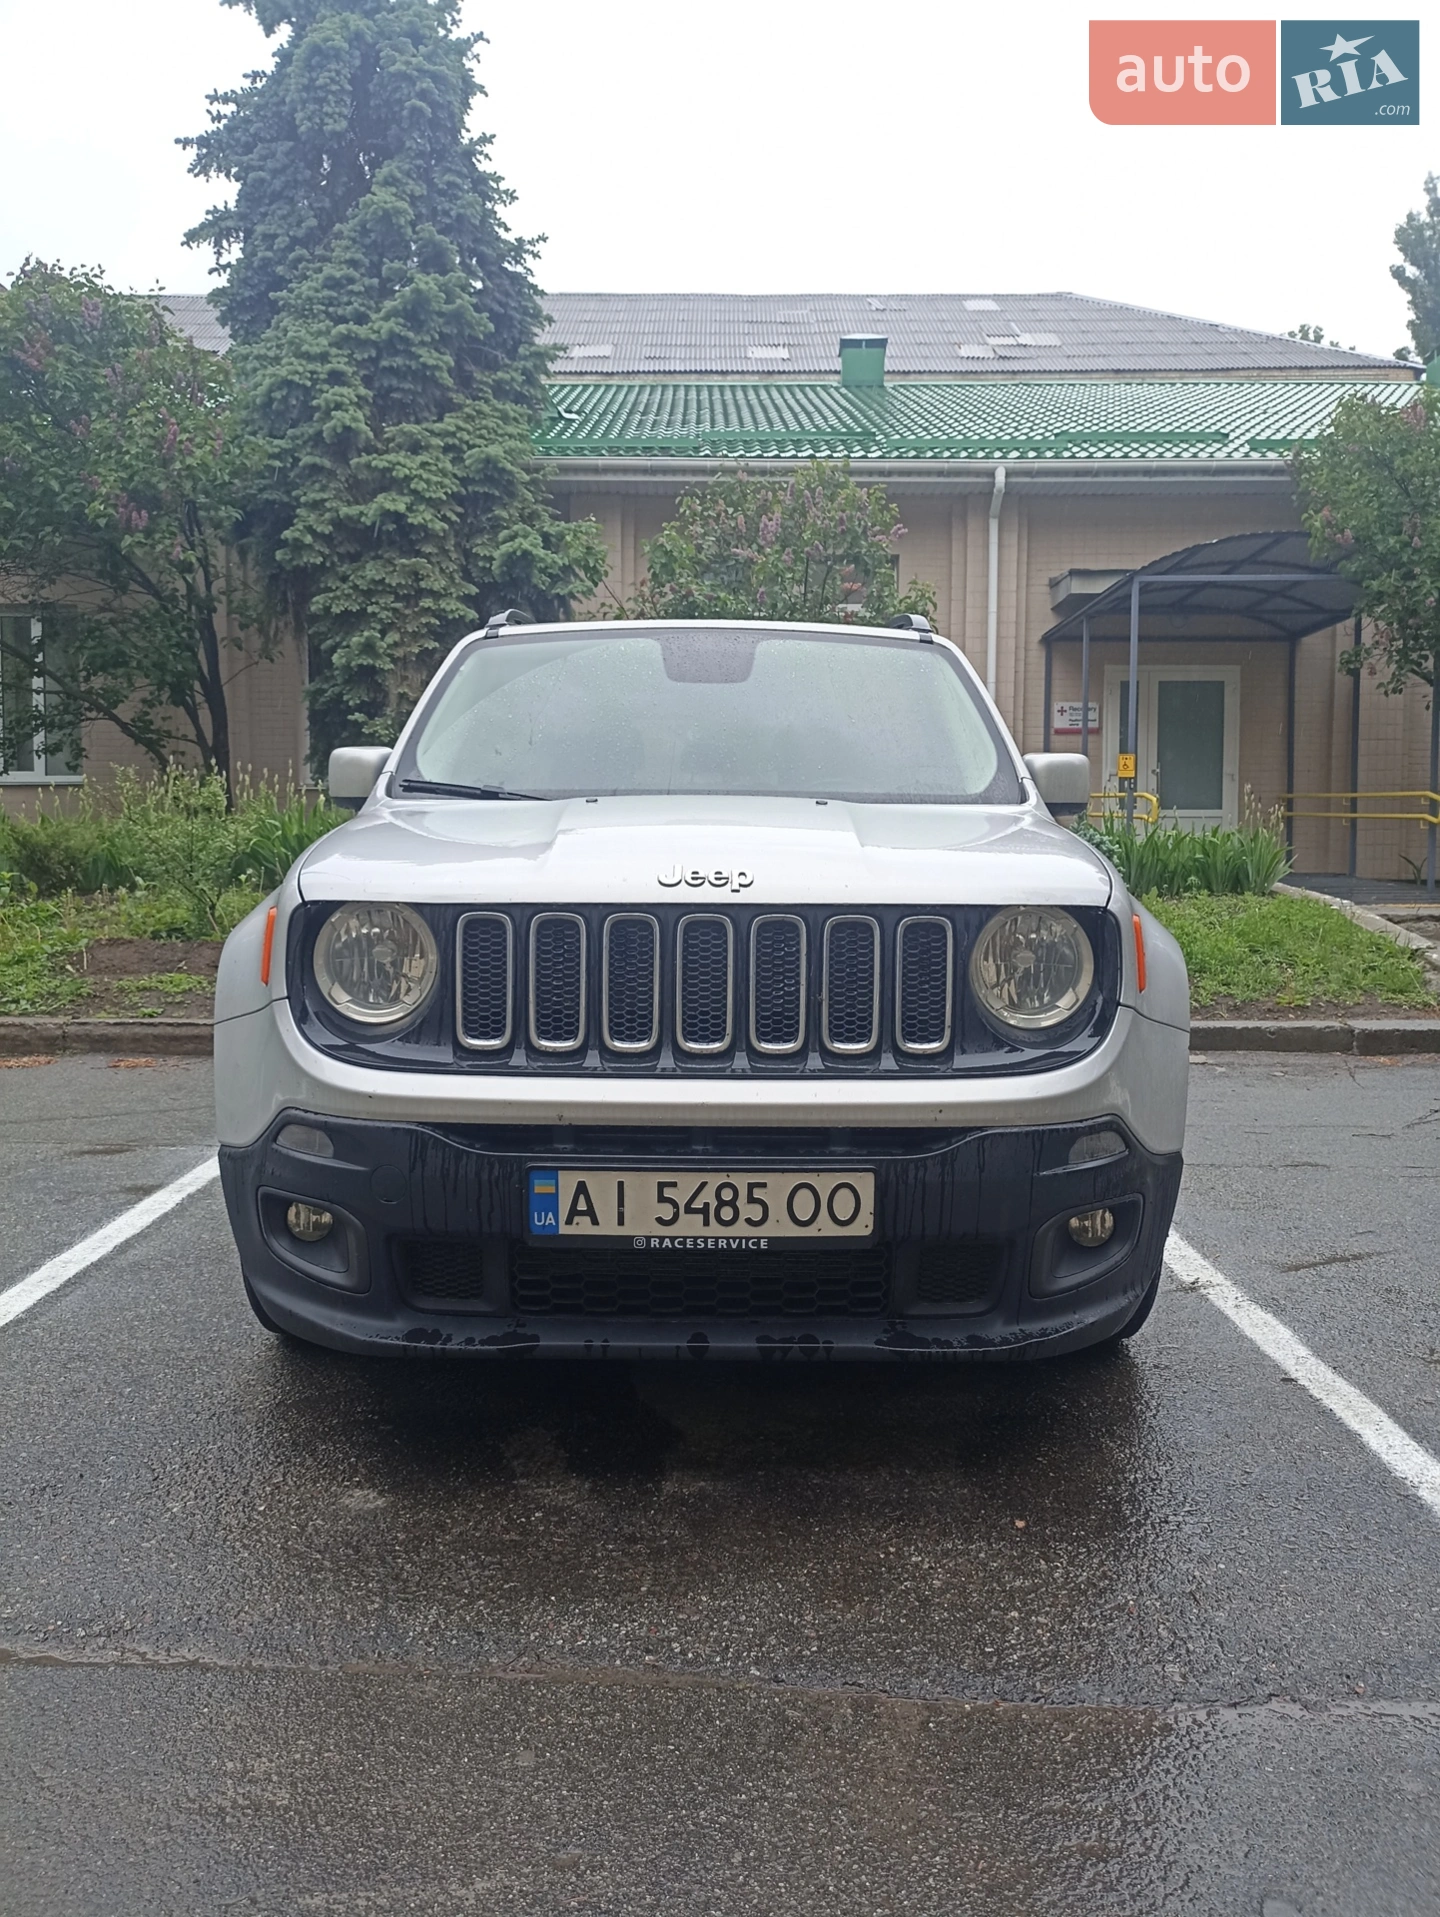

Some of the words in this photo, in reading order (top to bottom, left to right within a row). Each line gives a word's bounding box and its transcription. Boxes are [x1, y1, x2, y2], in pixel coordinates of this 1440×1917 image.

[1069, 705, 1097, 713] Recery
[657, 864, 755, 893] Jeep
[564, 1180, 625, 1227] AI
[654, 1180, 770, 1228] 5485
[786, 1181, 862, 1228] OO
[534, 1211, 556, 1226] UA
[650, 1237, 769, 1249] RACESERVICE
